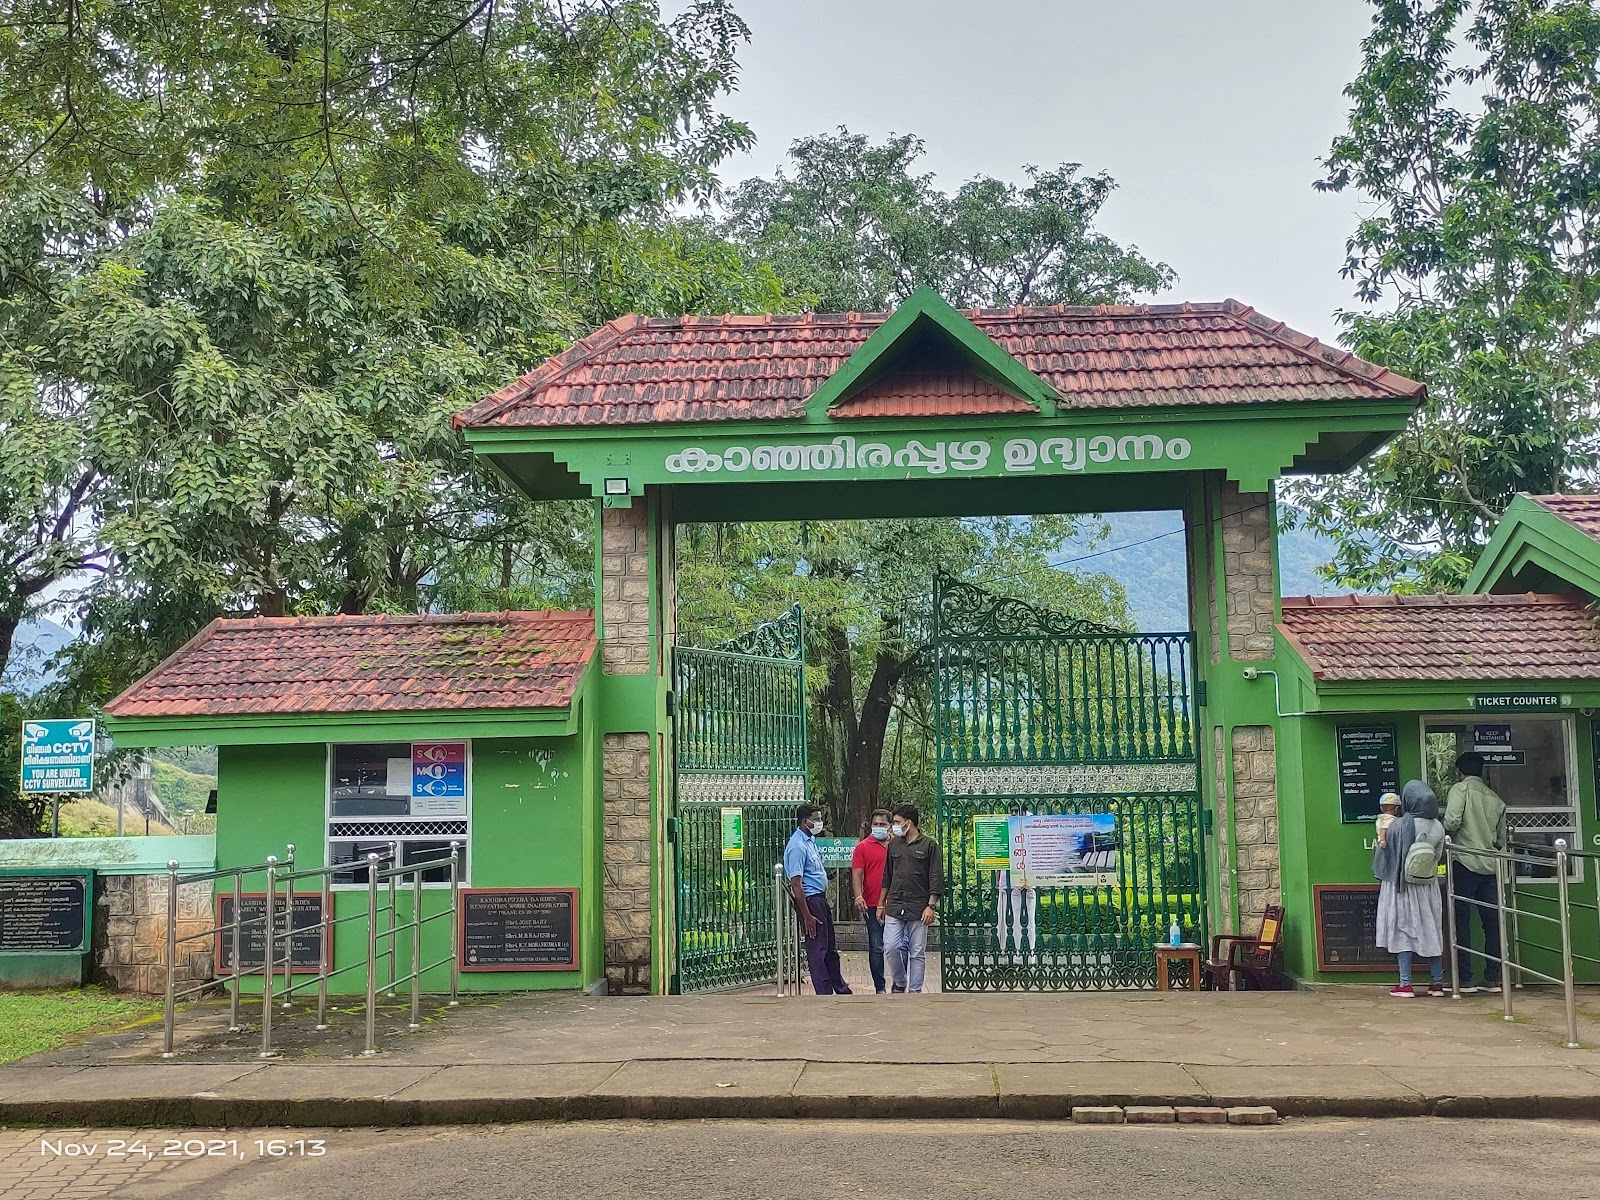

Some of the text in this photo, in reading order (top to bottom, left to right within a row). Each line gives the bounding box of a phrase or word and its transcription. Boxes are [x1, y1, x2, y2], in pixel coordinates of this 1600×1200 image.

[665, 434, 1191, 474] കാഞ്ഞിരപ്പുഴ ഉദ്യാനം
[1477, 696, 1558, 706] TICKET COUNTER
[52, 742, 89, 753] CCTV
[31, 768, 81, 778] YOU ARE UNDER
[24, 778, 88, 789] CCTV SURVEILLANCE
